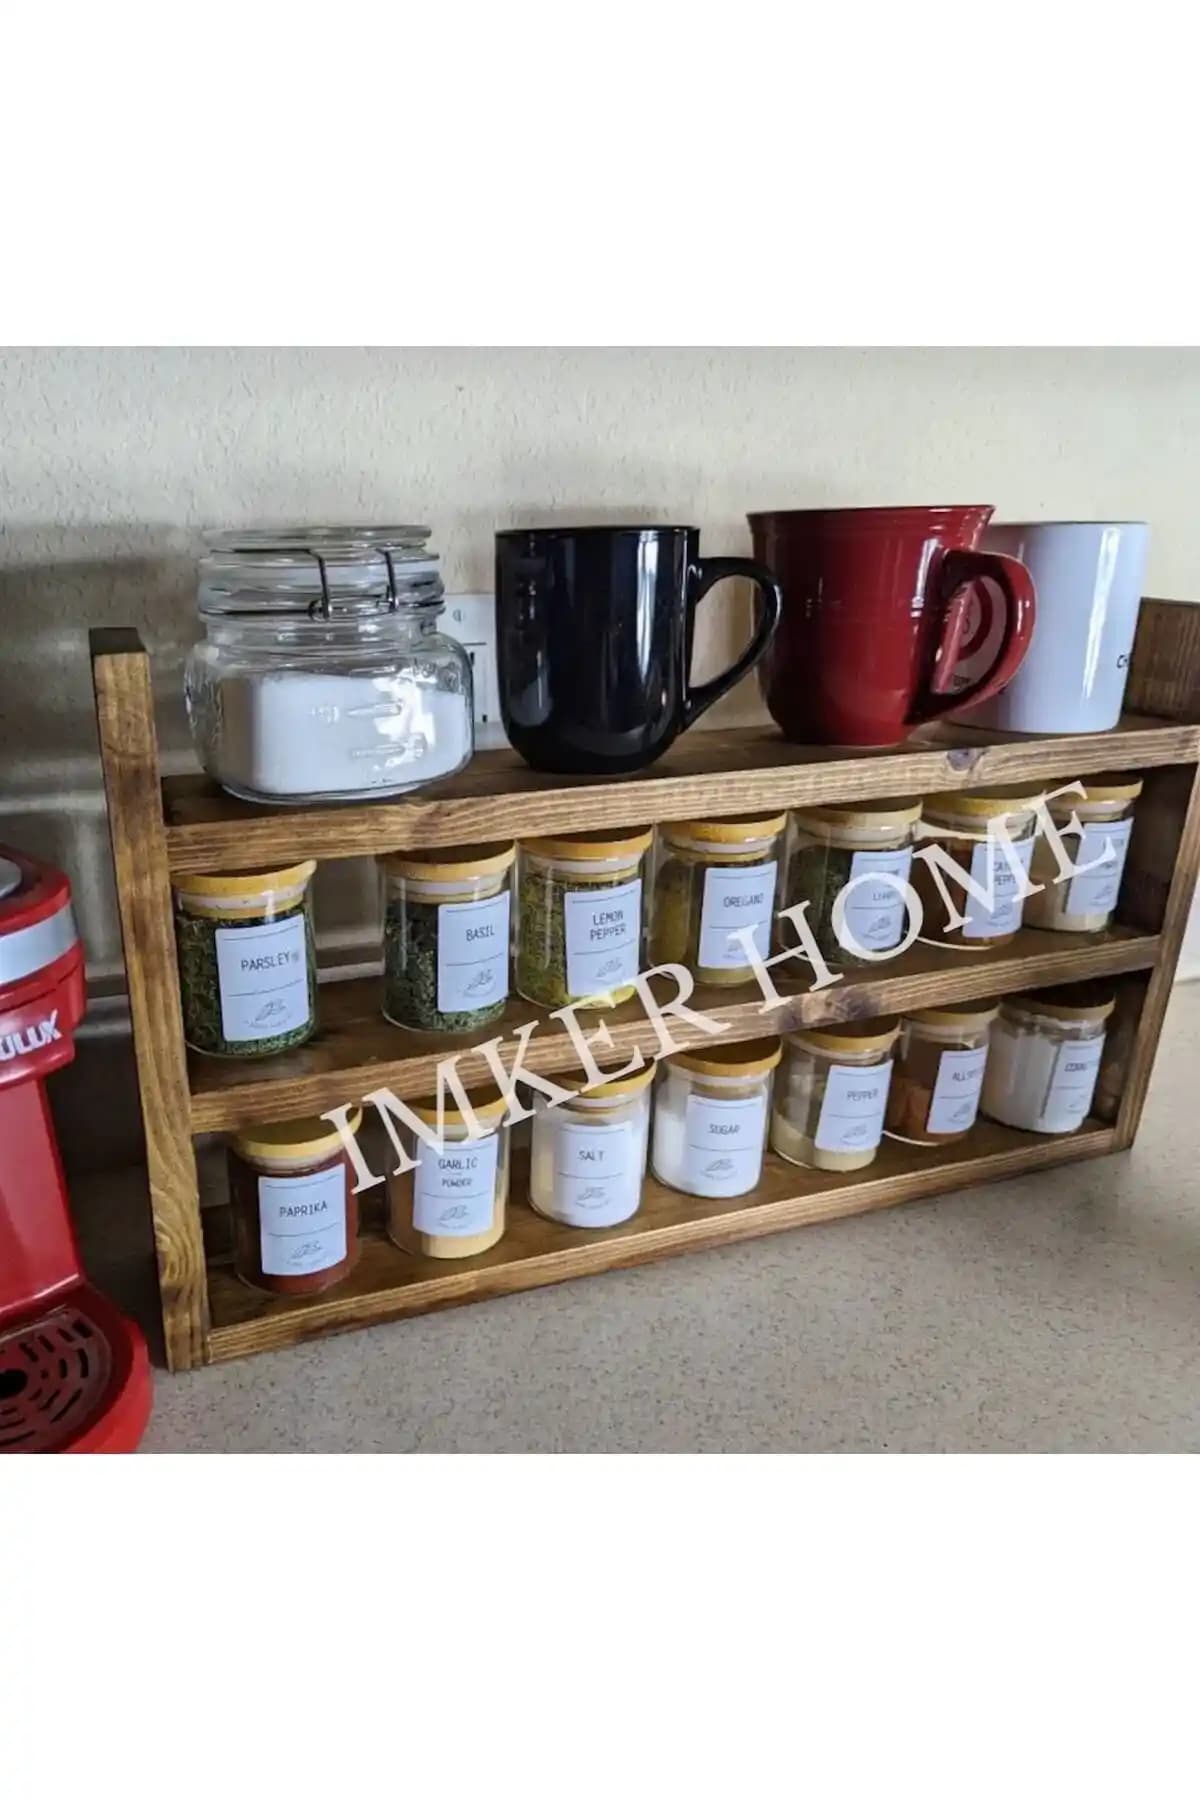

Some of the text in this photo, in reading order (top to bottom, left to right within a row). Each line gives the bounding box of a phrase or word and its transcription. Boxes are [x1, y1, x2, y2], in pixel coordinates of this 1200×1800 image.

[591, 909, 625, 926] LEMON
[464, 924, 496, 942] BASIL
[588, 923, 627, 942] PEPPER
[240, 950, 291, 973] PARSLEY
[708, 1123, 742, 1135] SUGAR
[437, 1156, 479, 1170] GARLIC
[577, 1150, 604, 1162] SALT
[279, 1200, 328, 1218] PAPRIKA
